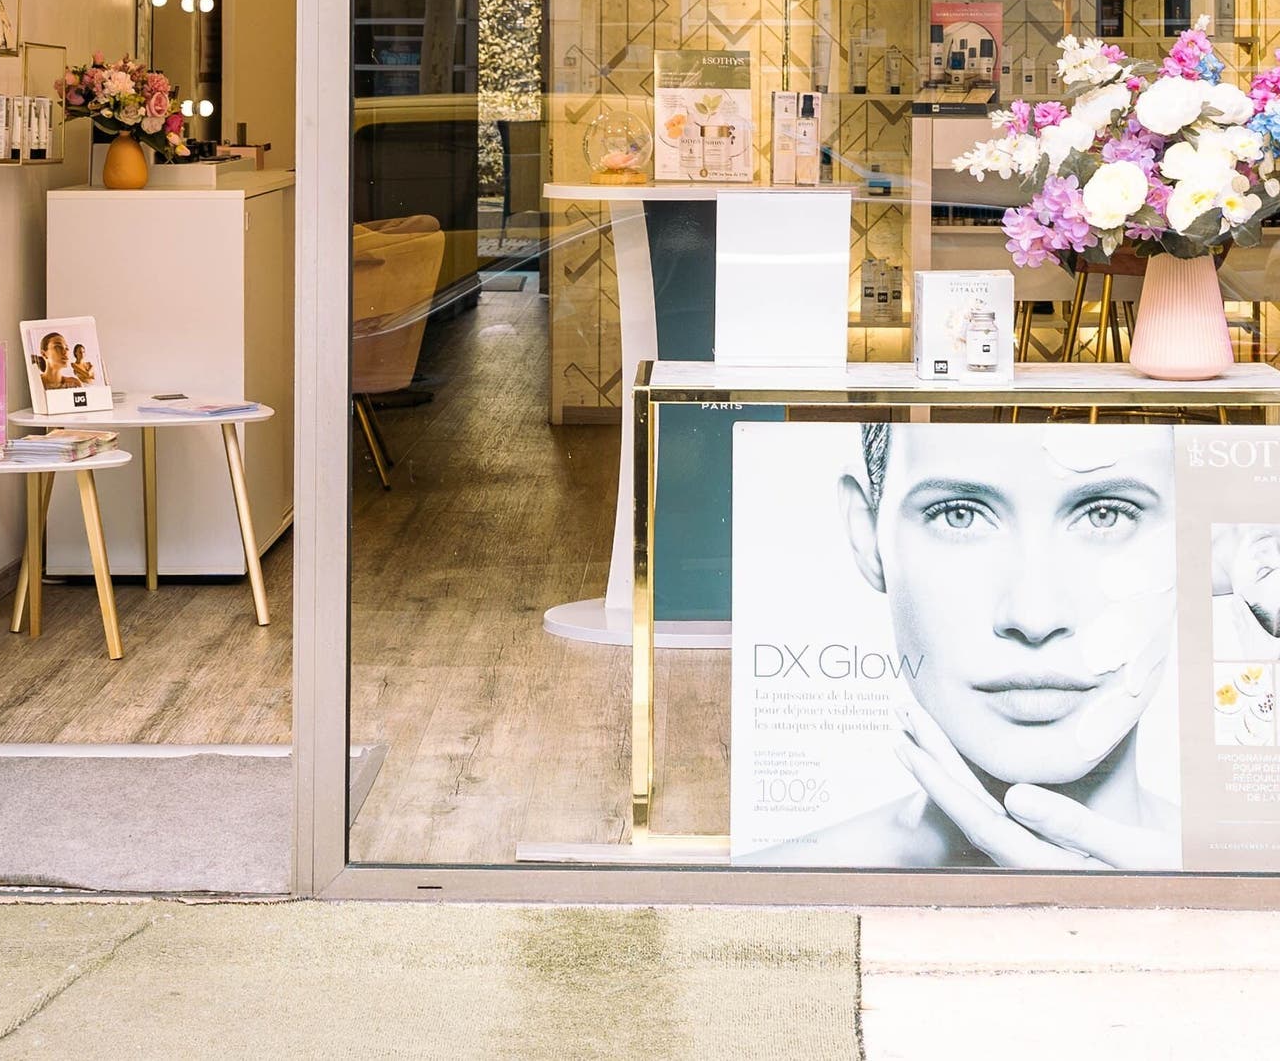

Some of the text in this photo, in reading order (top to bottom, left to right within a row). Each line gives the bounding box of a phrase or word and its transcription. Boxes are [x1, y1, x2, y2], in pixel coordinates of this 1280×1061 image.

[754, 644, 925, 680] DX Glow
[754, 689, 770, 701] La
[756, 778, 830, 803] 100%
